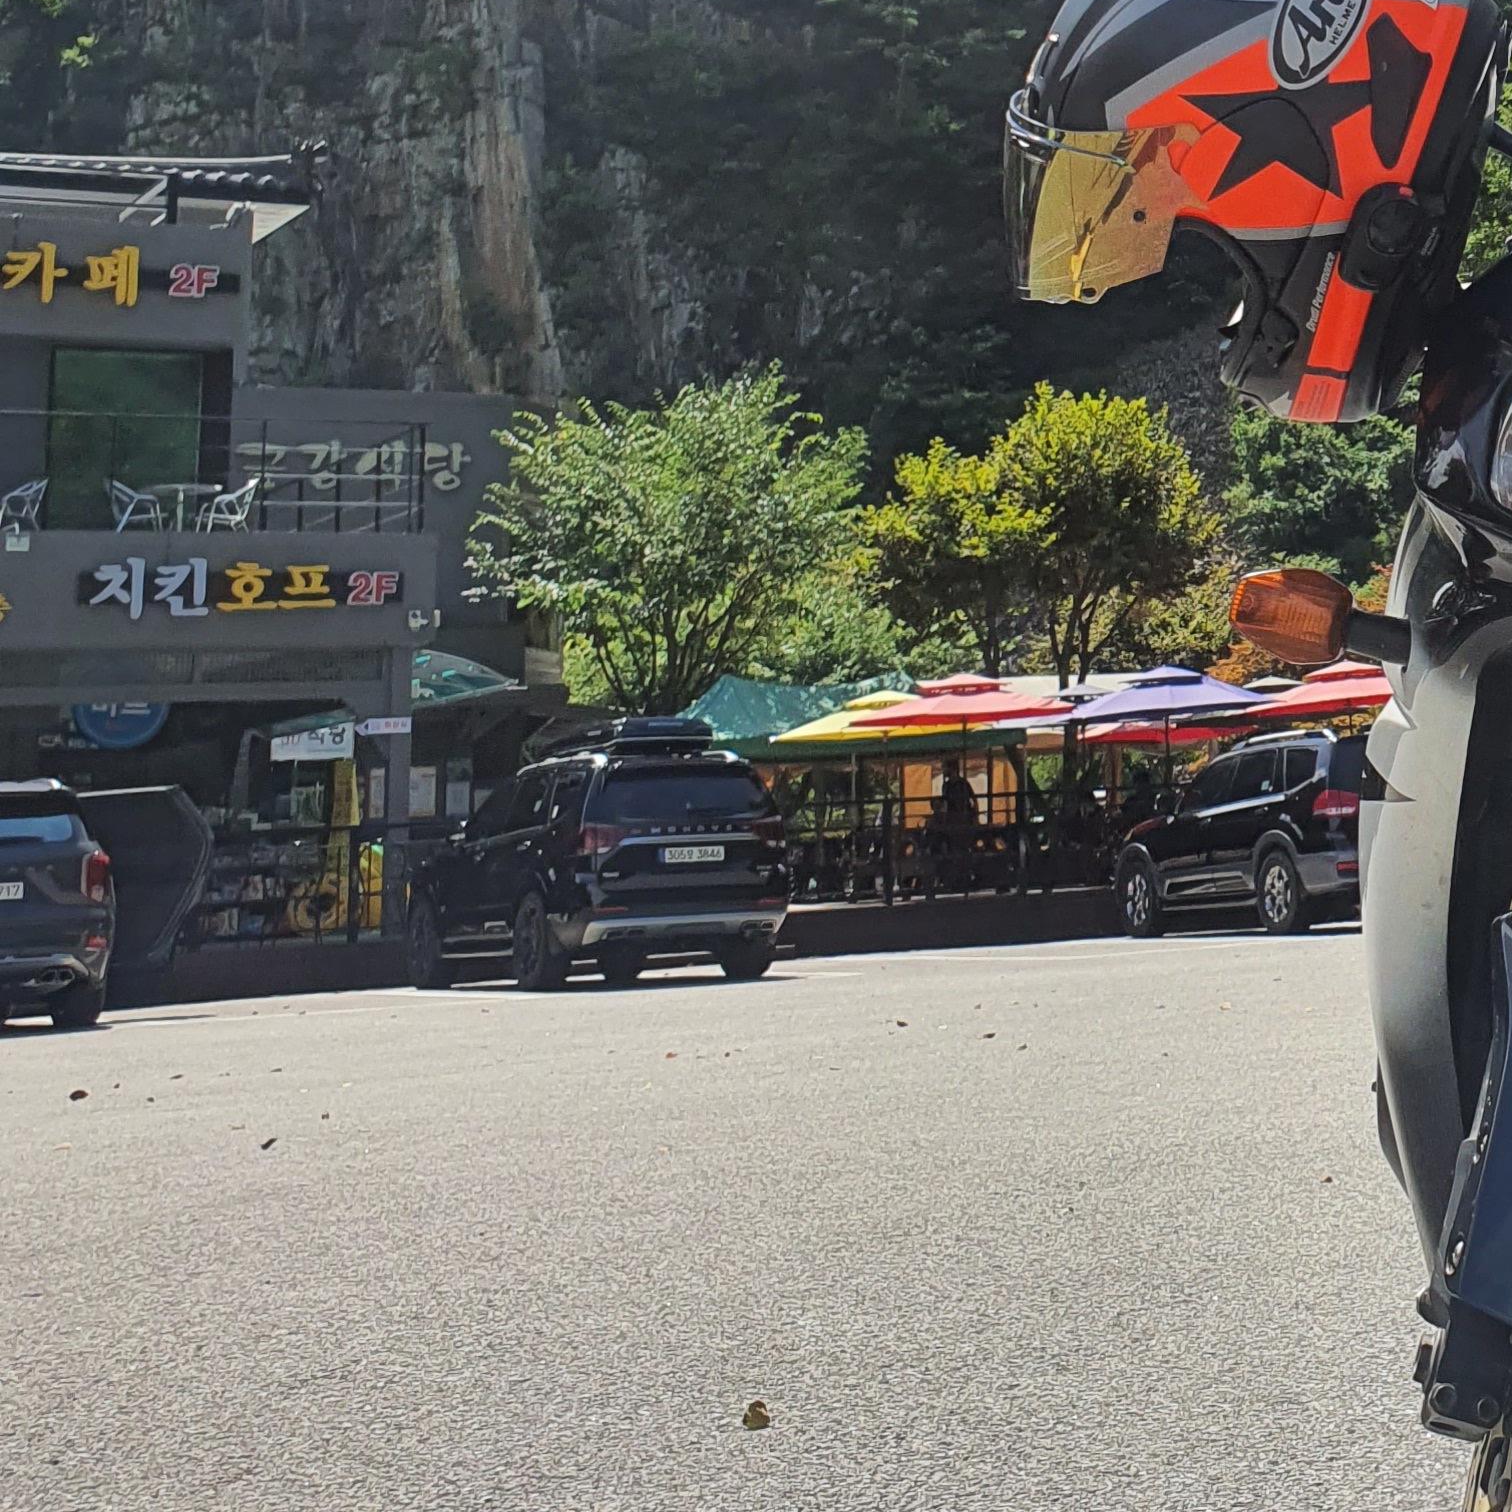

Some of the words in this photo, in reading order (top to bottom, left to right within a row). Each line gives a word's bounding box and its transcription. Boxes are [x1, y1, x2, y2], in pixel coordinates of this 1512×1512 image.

[2, 241, 139, 307] 카페
[168, 263, 220, 299] 2F
[346, 571, 400, 606] 2F
